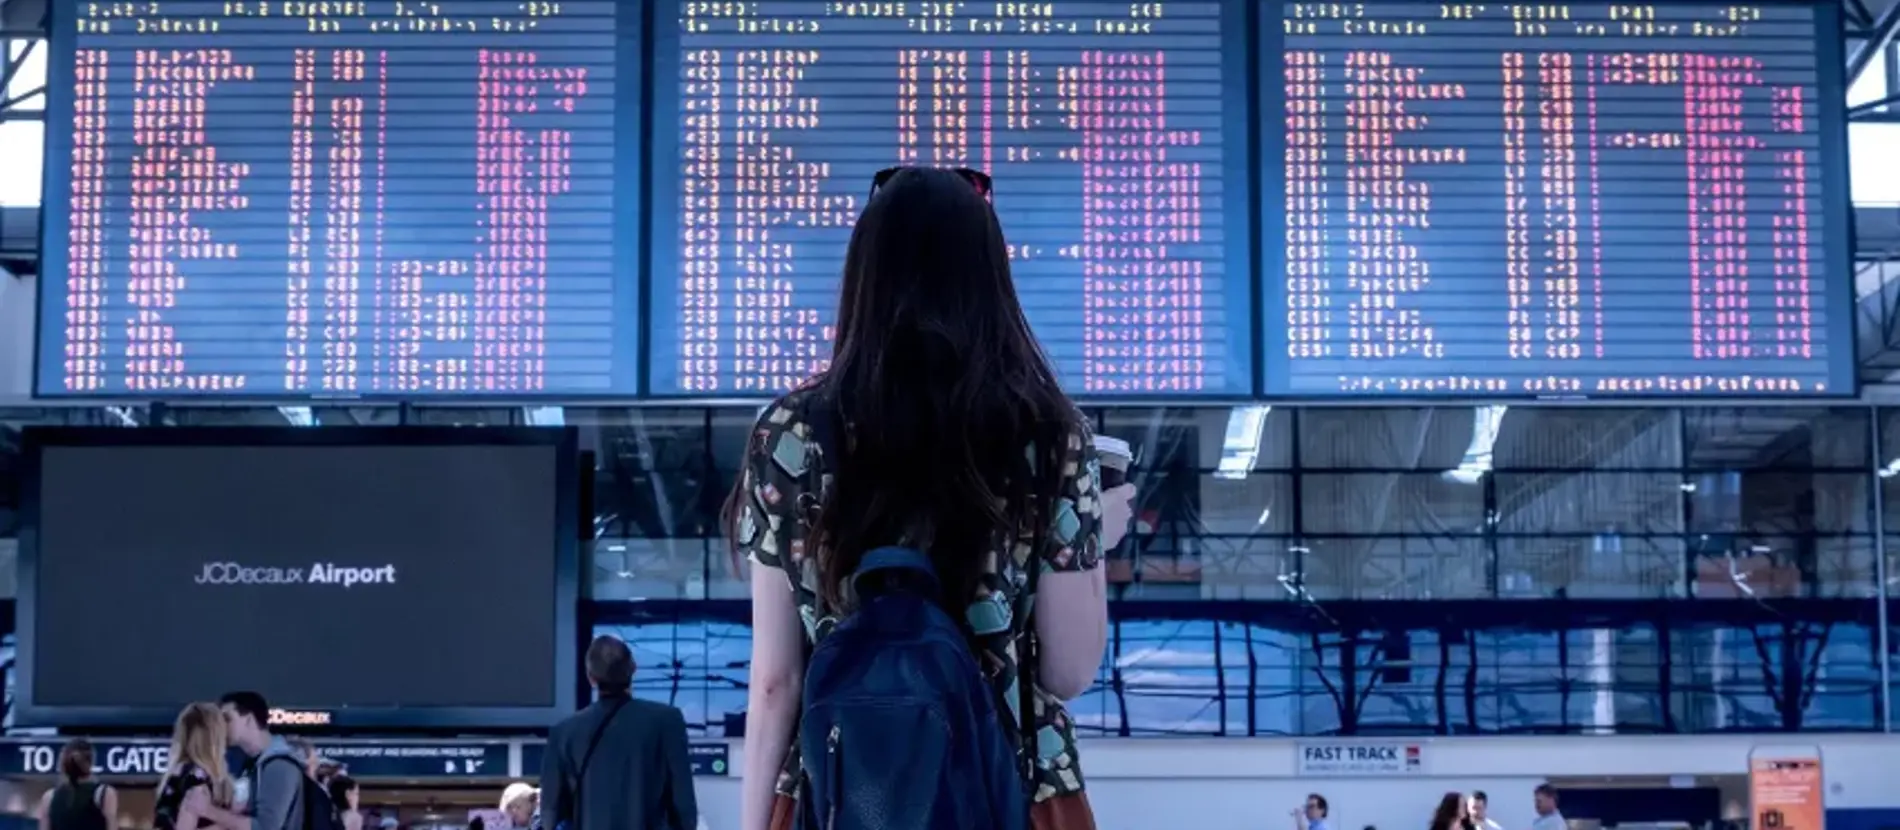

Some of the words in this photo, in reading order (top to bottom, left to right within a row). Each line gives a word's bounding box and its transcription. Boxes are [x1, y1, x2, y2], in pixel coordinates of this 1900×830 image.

[195, 562, 302, 583] JCDecaux
[308, 562, 395, 586] Airport
[20, 746, 54, 773] TO
[1305, 746, 1342, 760] FAST
[1348, 746, 1398, 760] TRACK
